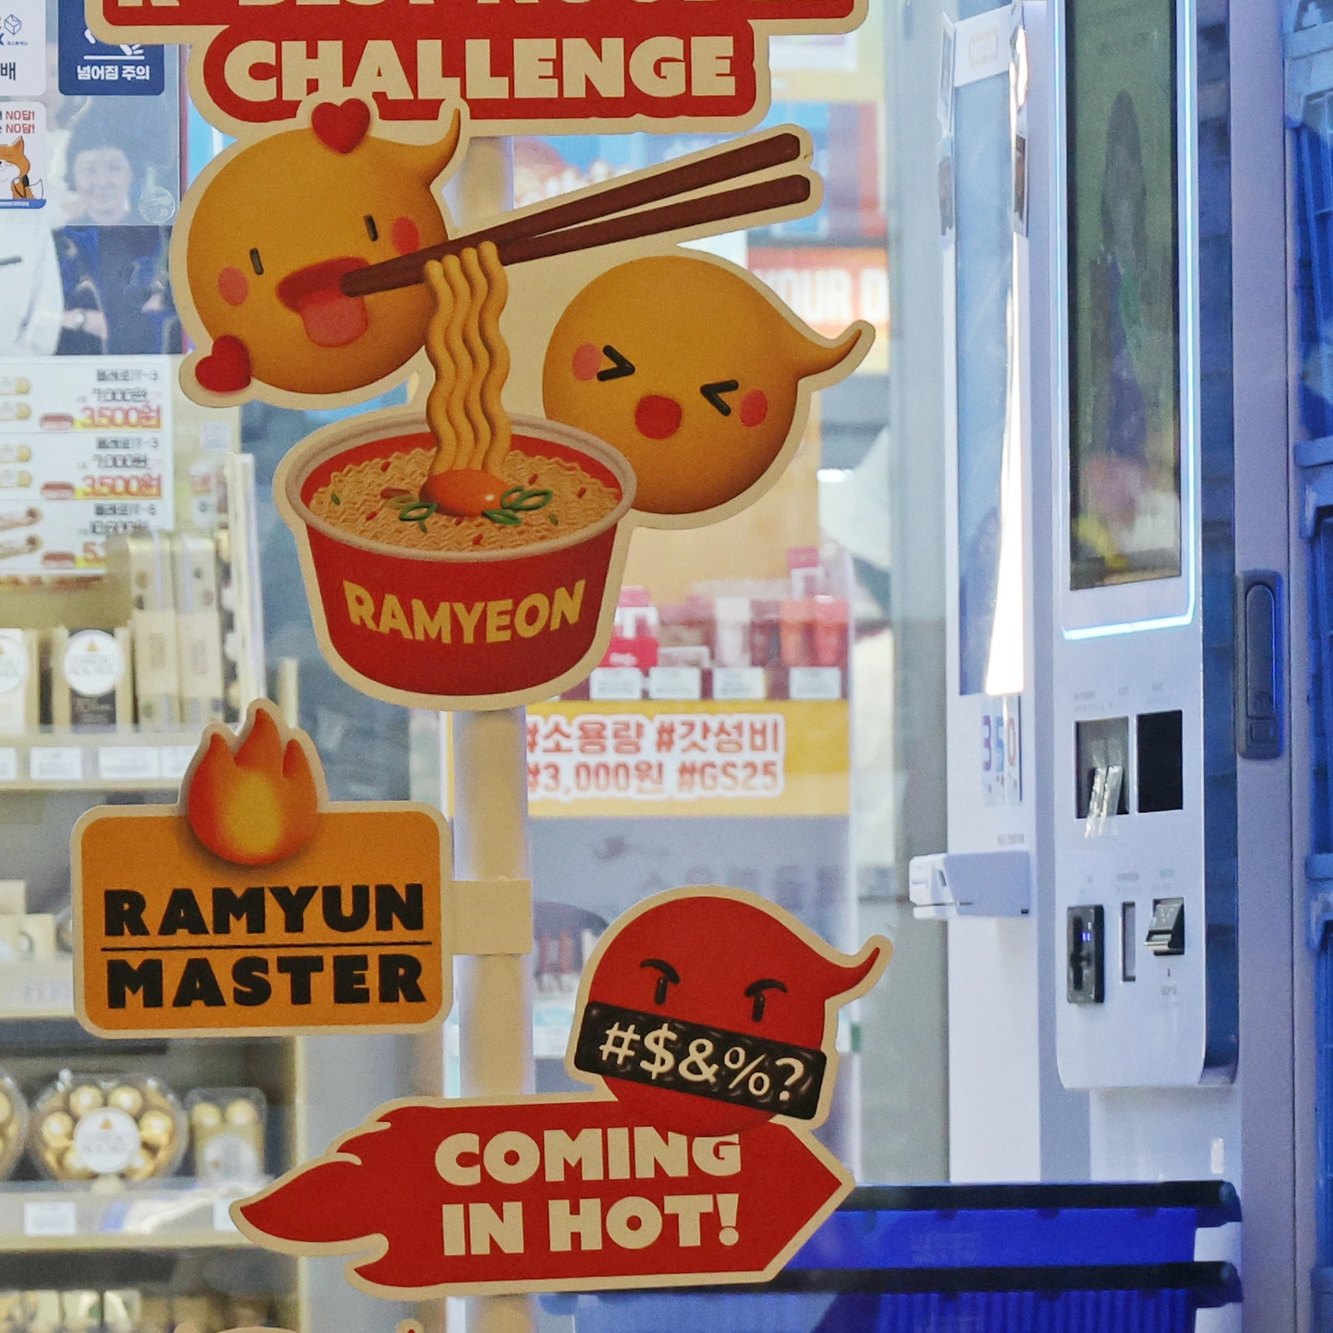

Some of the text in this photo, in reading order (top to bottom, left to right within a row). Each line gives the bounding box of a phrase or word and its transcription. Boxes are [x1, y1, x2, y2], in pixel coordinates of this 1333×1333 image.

[77, 65, 149, 80] 넘어짐 주의
[224, 36, 735, 102] CHALLENGE
[344, 579, 585, 644] RAMYEON
[656, 719, 780, 755] #갓성비
[678, 760, 778, 792] #GS25
[103, 882, 425, 937] RAMYUN
[106, 953, 427, 1010] MASTER
[435, 1126, 742, 1187] COMING
[442, 1193, 740, 1257] IN HOT!
